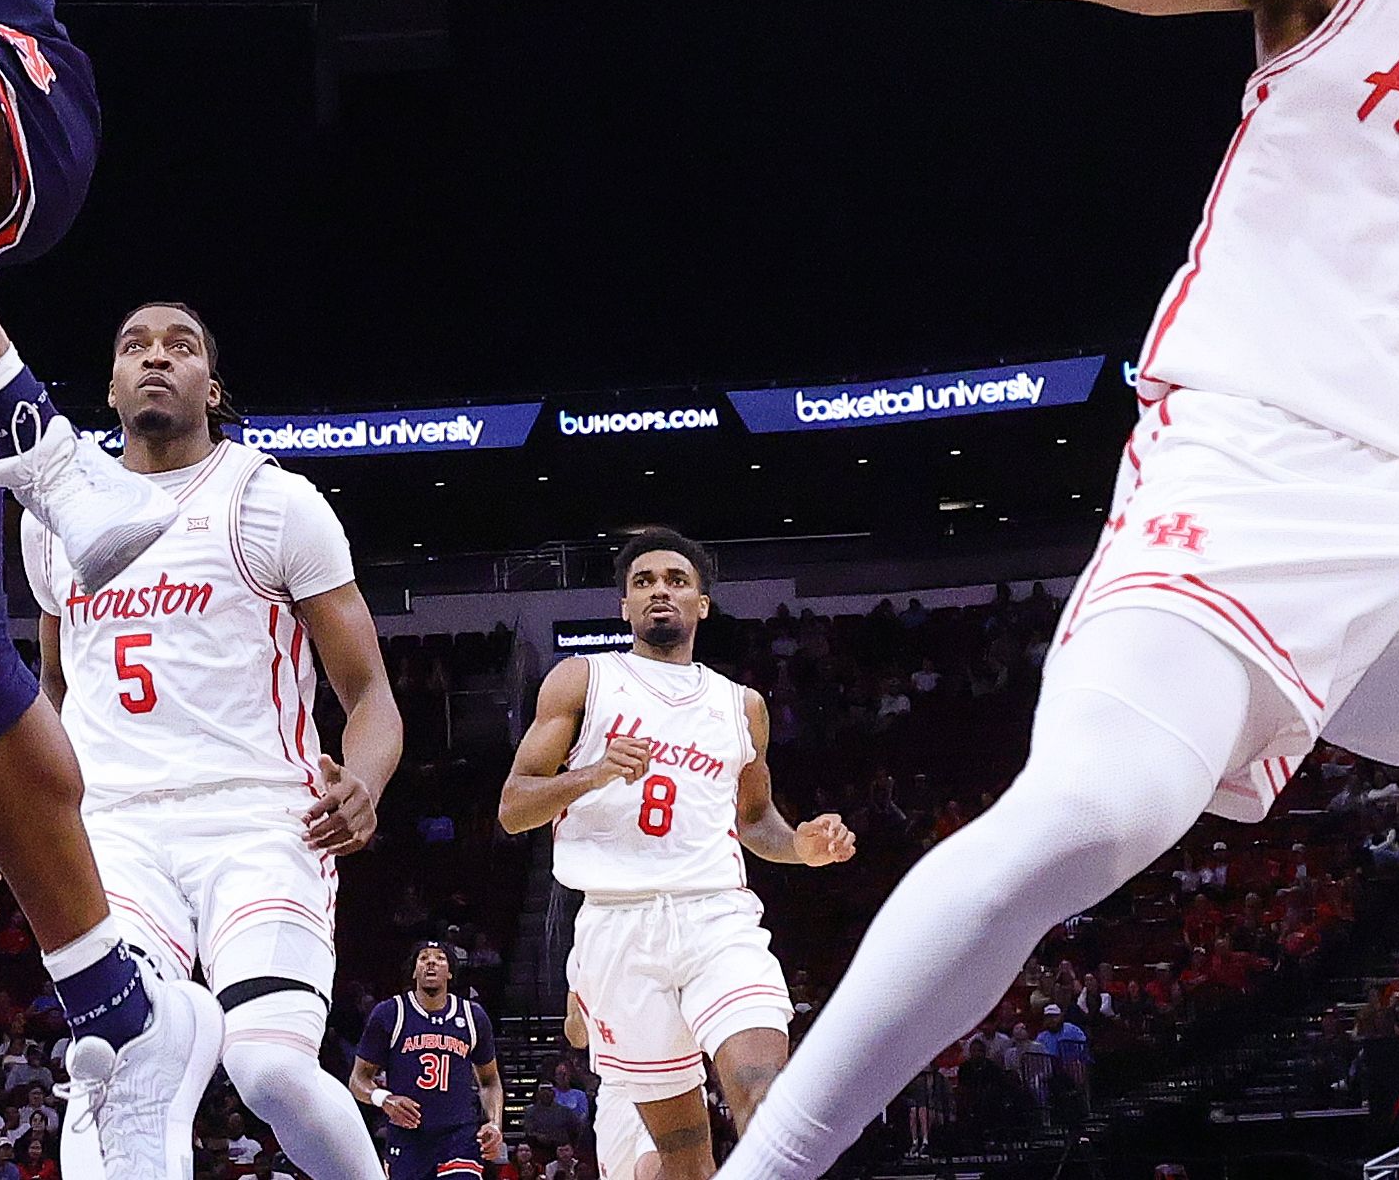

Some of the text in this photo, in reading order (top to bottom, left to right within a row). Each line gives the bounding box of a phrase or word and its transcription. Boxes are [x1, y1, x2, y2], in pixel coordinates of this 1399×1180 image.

[796, 372, 1044, 423] basketball university
[242, 415, 483, 451] basketball university
[65, 572, 213, 628] Houston
[114, 634, 158, 715] 5
[605, 713, 724, 780] Huston
[638, 774, 677, 838] 8
[401, 1033, 470, 1060] AUBURN
[416, 1052, 451, 1092] 31
